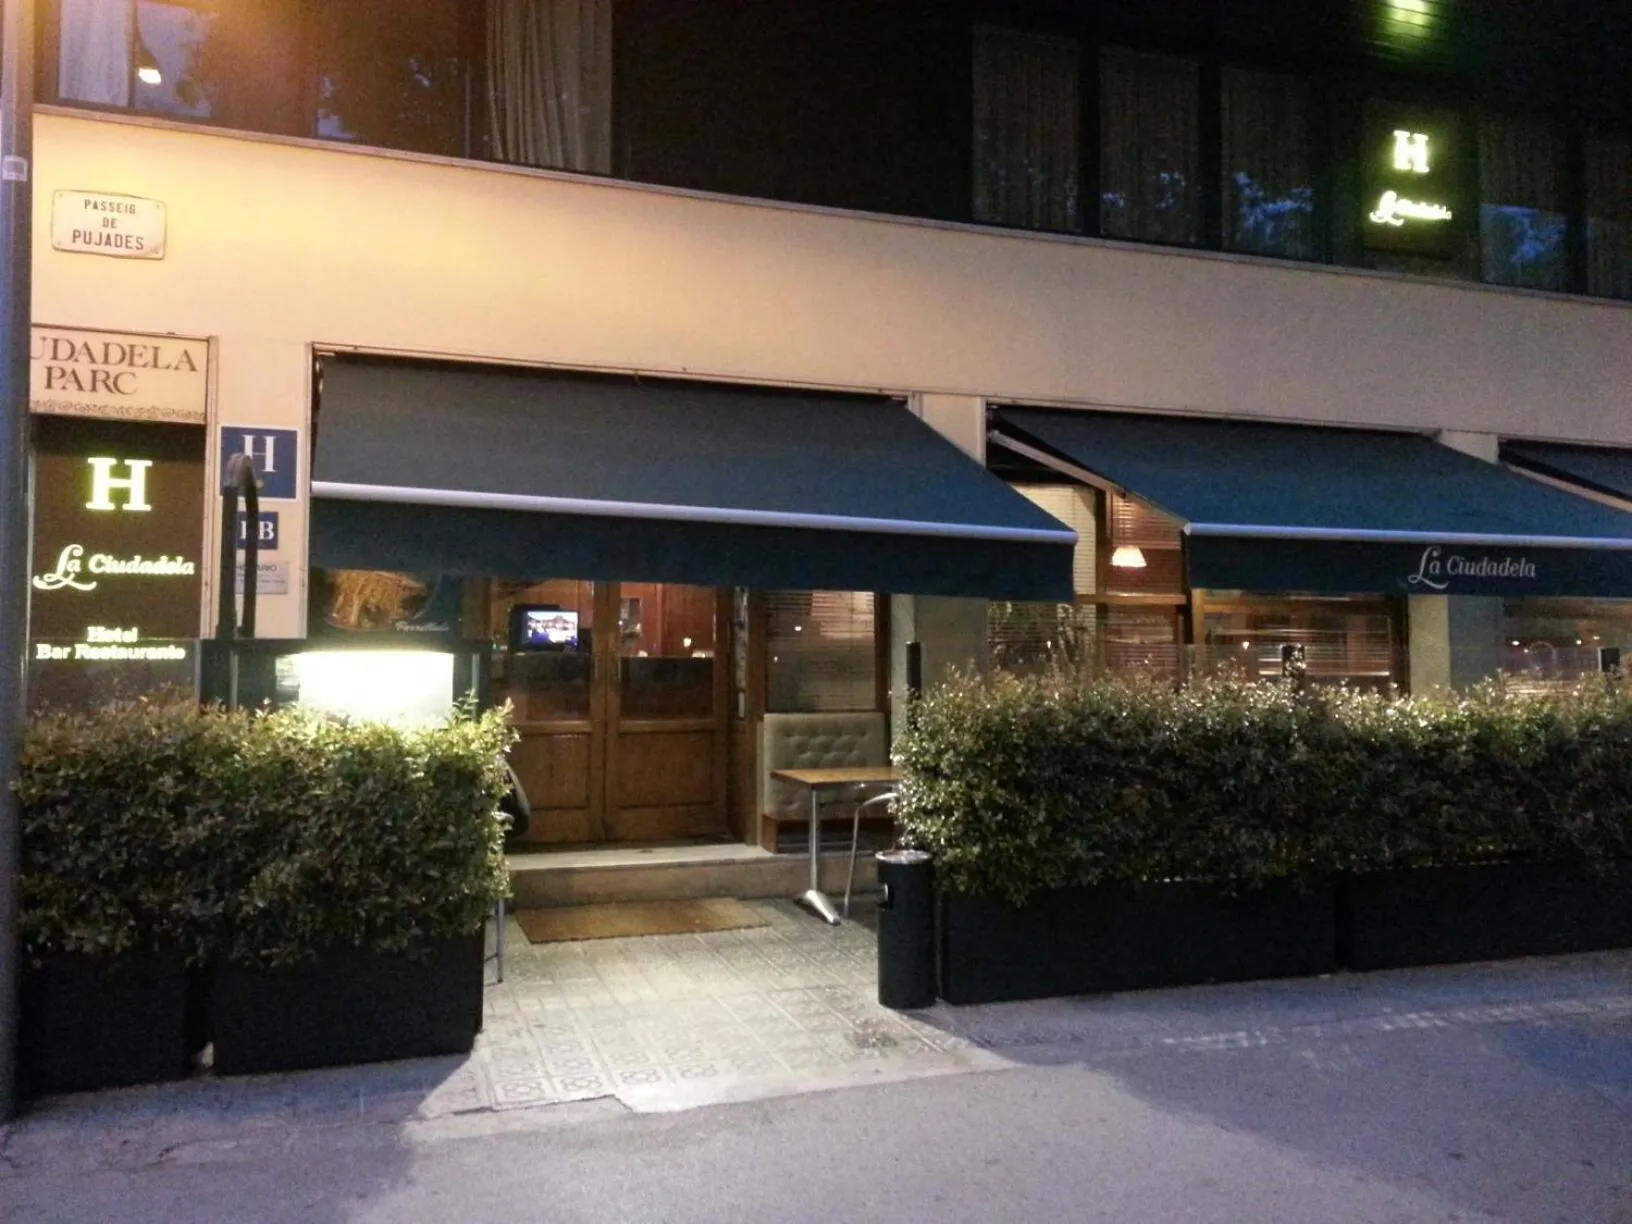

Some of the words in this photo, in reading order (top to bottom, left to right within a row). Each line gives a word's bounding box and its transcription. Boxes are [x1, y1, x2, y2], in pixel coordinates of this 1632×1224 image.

[1394, 130, 1430, 173] H
[84, 199, 136, 215] PASSEIG
[102, 217, 117, 229] DE
[72, 230, 145, 251] PUJADES
[44, 366, 137, 395] PARC
[85, 457, 153, 511] H
[33, 544, 97, 591] La
[89, 554, 195, 576] Ciudadela
[1408, 545, 1449, 589] La
[1448, 556, 1537, 578] Ciudadela
[87, 627, 138, 643] Hotel
[36, 643, 71, 660] Bar
